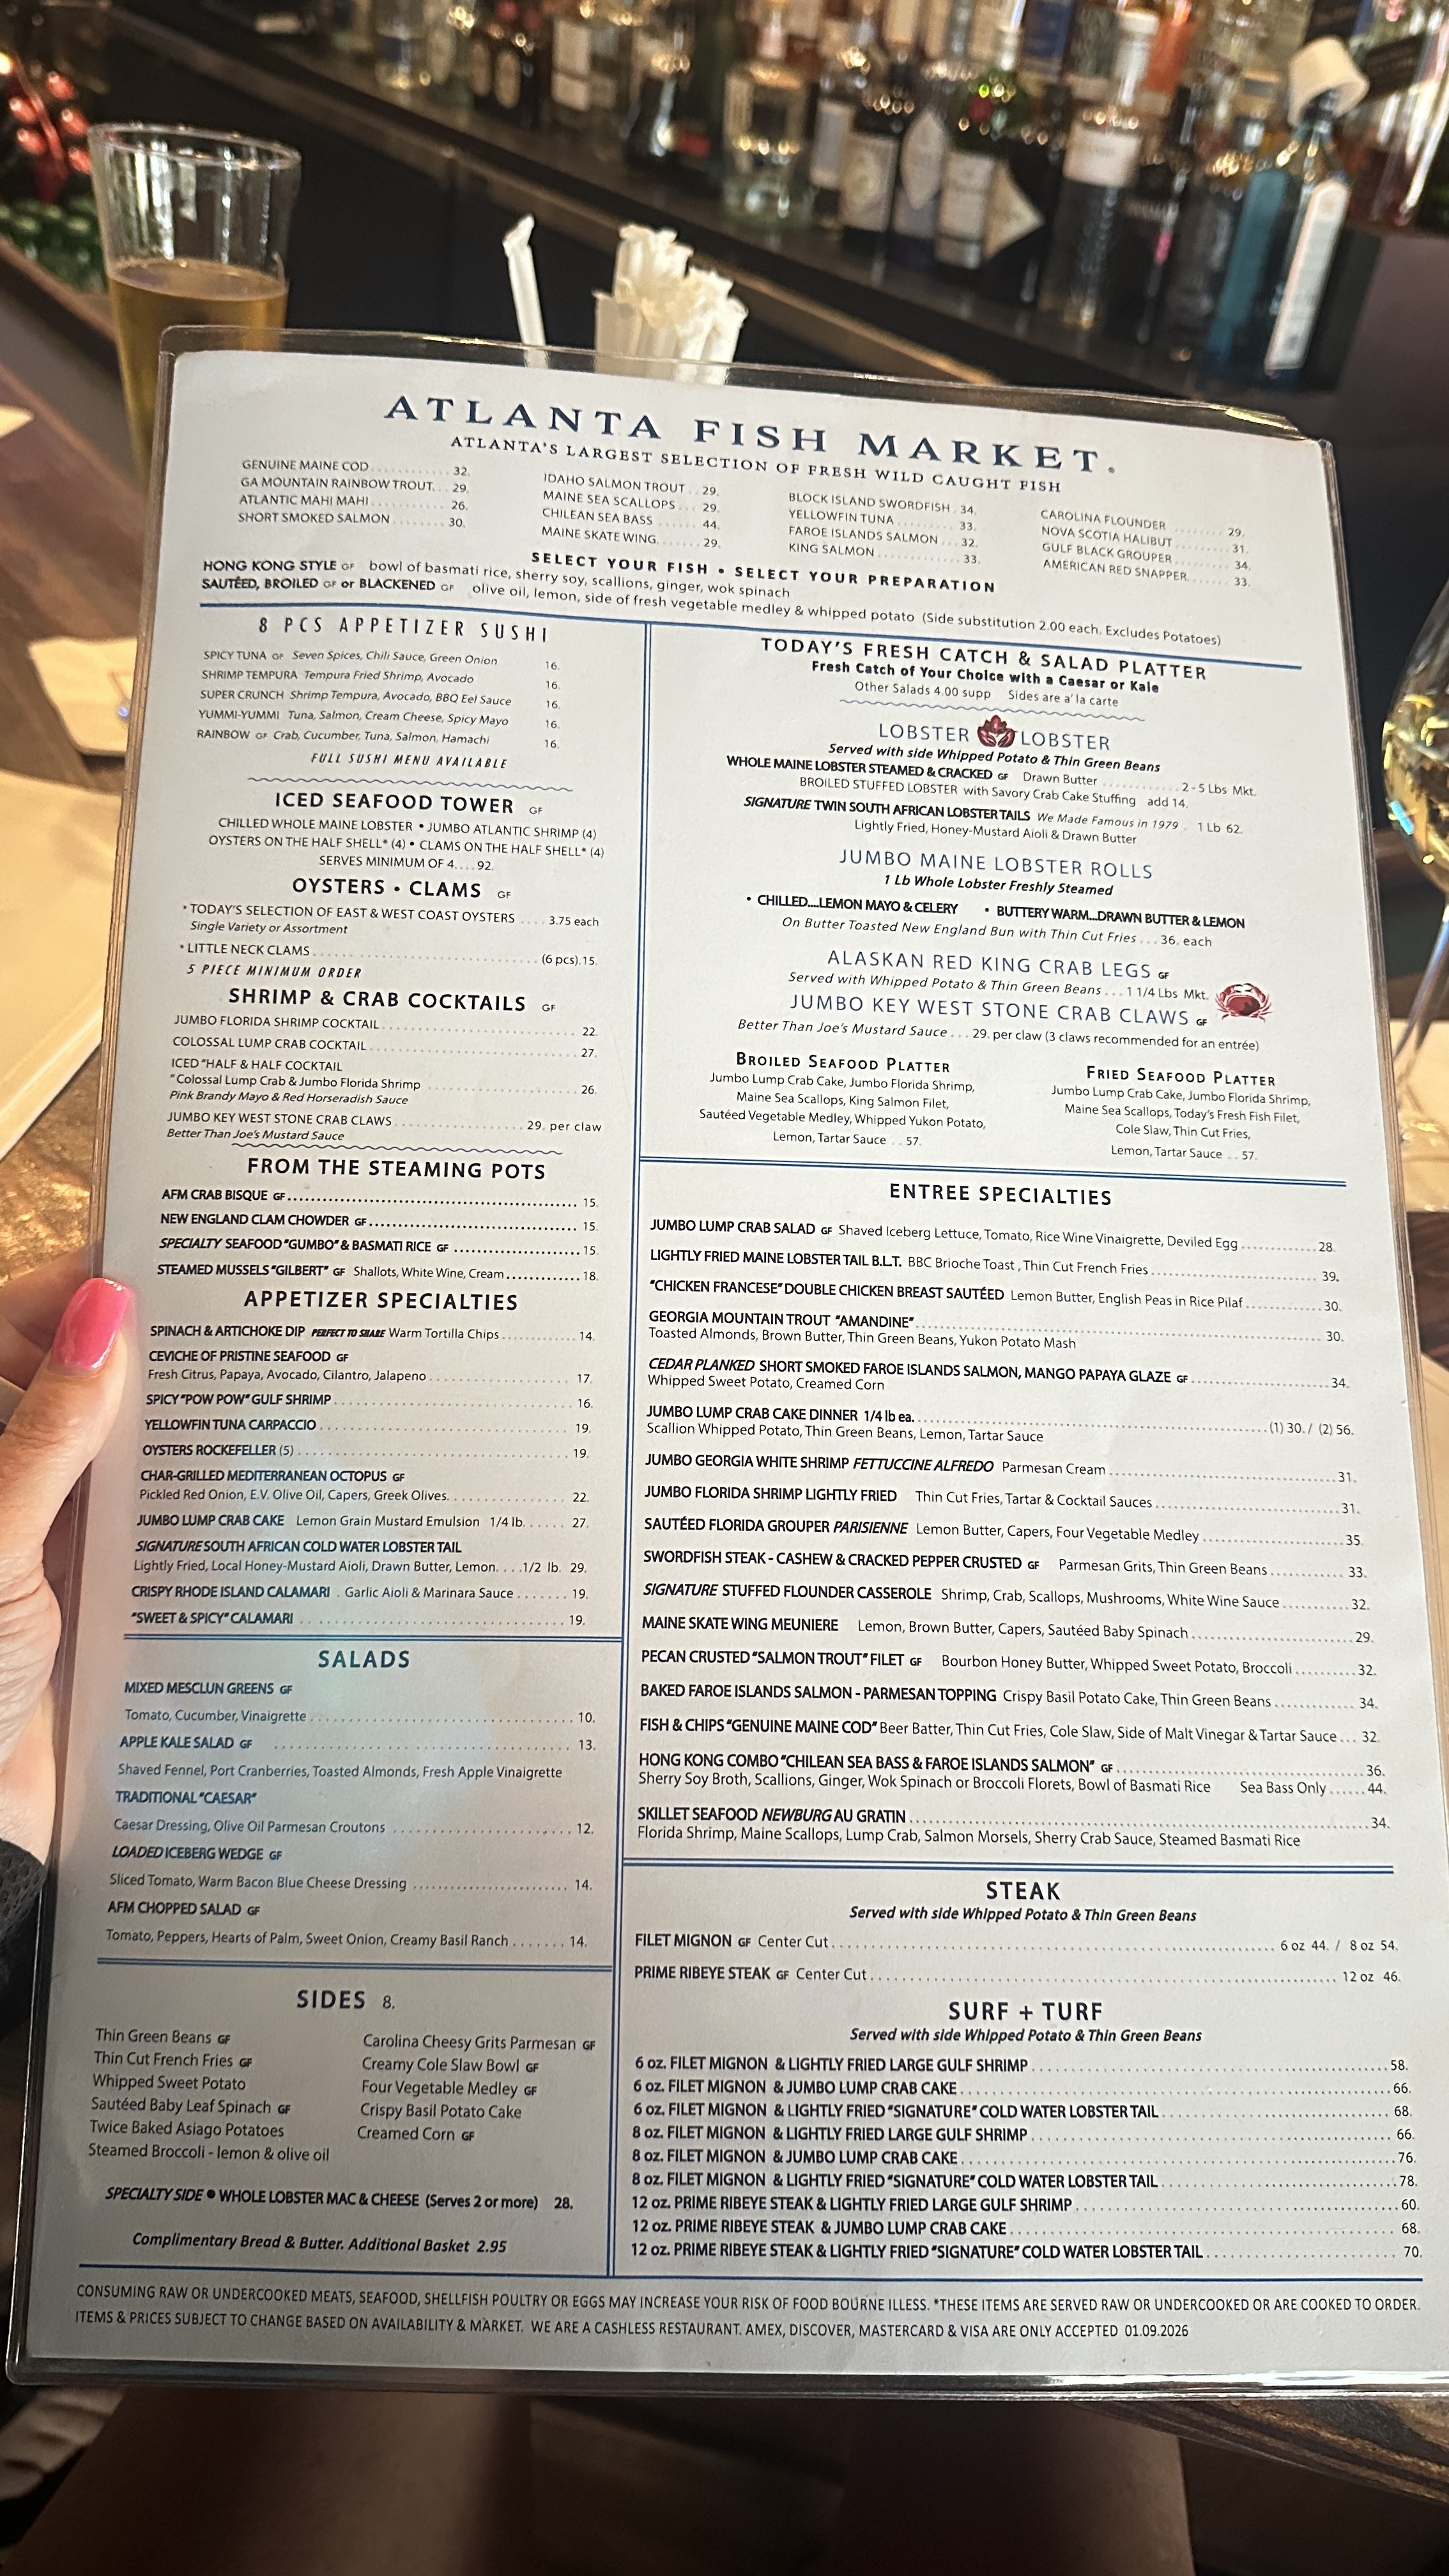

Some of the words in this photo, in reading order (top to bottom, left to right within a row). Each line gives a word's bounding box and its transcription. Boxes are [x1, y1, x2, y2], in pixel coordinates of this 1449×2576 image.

[383, 395, 661, 440] ATLANTA
[694, 419, 826, 452] FISH
[858, 433, 1098, 473] MARKET
[241, 459, 296, 470] GENUINE
[299, 459, 339, 471] MAINE
[342, 461, 369, 472] COD
[450, 436, 558, 455] ATLANTA'S
[566, 445, 652, 463] LARGEST
[661, 453, 767, 472] SELECTION
[776, 463, 799, 474] OF
[808, 464, 866, 479] FRESH
[875, 470, 924, 483] WILD
[932, 475, 1011, 490] CAUGHT
[1020, 480, 1060, 493] FISH
[542, 507, 595, 521] CHILEAN
[597, 512, 620, 523] SEA
[623, 514, 653, 526] BASS
[788, 509, 857, 523] YELLOWFIN
[860, 514, 894, 525] TUNA
[1040, 509, 1101, 524] CAROLINA
[1104, 514, 1166, 530] FLOUNDER
[532, 552, 597, 567] SELECT
[607, 558, 657, 572] YOUR
[667, 562, 707, 574] FISH
[735, 566, 799, 581] SELECT
[809, 571, 858, 585] YOUR
[868, 574, 994, 593] PREPARATION
[259, 617, 268, 633] 8
[284, 617, 322, 633] PCS
[339, 617, 464, 636] APPETIZER
[480, 622, 546, 643] SUSHI
[761, 637, 853, 656] TODAY'S
[864, 643, 928, 660] FRESH
[940, 648, 1008, 664] CATCH
[1018, 650, 1031, 666] &
[1041, 654, 1108, 671] SALAD
[1119, 659, 1206, 680] PLATTER
[201, 670, 244, 680] SHRIMP
[245, 670, 298, 680] TEMPURA
[304, 670, 351, 682] Tempura
[353, 670, 381, 680] Fried
[383, 670, 424, 684] Shrimp,
[426, 672, 474, 684] Avocado
[879, 723, 969, 742] LOBSTER
[1021, 730, 1110, 751] LOBSTER
[275, 792, 324, 808] ICED
[332, 793, 433, 810] SEAFOOD
[440, 795, 513, 814] TOWER
[529, 806, 543, 815] GF
[839, 849, 911, 866] JUMBO
[921, 853, 986, 870] MAINE
[995, 856, 1082, 875] LOBSTER
[1091, 861, 1152, 879] ROLLS
[293, 877, 385, 895] OYSTERS
[410, 880, 481, 898] CLAMS
[497, 891, 511, 899] GF
[190, 921, 226, 933] Single
[228, 921, 267, 935] Variety
[282, 923, 349, 934] Assortment
[827, 950, 923, 969] ALASKAN
[933, 954, 972, 970] RED
[982, 956, 1030, 973] KING
[1039, 959, 1092, 976] CRAB
[1102, 962, 1151, 979] LEGS
[229, 988, 311, 1005] SHRIMP
[320, 990, 335, 1006] &
[342, 990, 399, 1008] CRAB
[408, 992, 525, 1011] COCKTAILS
[542, 1004, 556, 1012] GF
[737, 1091, 772, 1103] Maine
[774, 1092, 794, 1103] Sea
[797, 1093, 846, 1107] Scallops,
[849, 1095, 875, 1109] King
[877, 1096, 919, 1108] Salmon
[923, 1098, 949, 1110] Filet,
[248, 1158, 309, 1174] FROM
[318, 1158, 360, 1176] THE
[369, 1160, 482, 1178] STEAMING
[491, 1163, 545, 1180] POTS
[890, 1183, 970, 1200] ENTREE
[979, 1186, 1111, 1206] SPECIALTIES
[160, 1213, 189, 1224] NEW
[191, 1213, 249, 1225] ENGLAND
[251, 1213, 286, 1225] CLAM
[288, 1214, 349, 1227] CHOWDER
[354, 1218, 367, 1227] GF
[243, 1290, 367, 1308] APPETIZER
[377, 1292, 518, 1311] SPECIALTIES
[144, 1419, 211, 1430] YELLOWFIN
[211, 1418, 247, 1430] TUNA
[249, 1419, 317, 1430] CARPACCIO
[576, 1423, 591, 1434] 19.
[642, 1616, 686, 1629] MAINE
[688, 1616, 729, 1630] SKATE
[730, 1617, 768, 1630] WING
[770, 1618, 839, 1632] MEUNIERE
[858, 1620, 905, 1634] Lemon,
[909, 1620, 949, 1633] Brown
[953, 1621, 995, 1636] Butter,
[998, 1622, 1045, 1638] Capers,
[1048, 1623, 1100, 1637] Sautéed
[1103, 1625, 1135, 1641] Baby
[1138, 1625, 1188, 1641] Spinach
[318, 1650, 410, 1669] SALADS
[114, 1818, 154, 1831] Caesar
[156, 1819, 211, 1835] Dressing,
[213, 1820, 245, 1832] Olive
[247, 1820, 264, 1832] Oil
[267, 1820, 326, 1833] Parmesan
[329, 1821, 385, 1834] Croutons
[577, 1822, 594, 1835] 12.
[986, 1881, 1061, 1901] STEAK
[634, 1965, 677, 1979] PRIME
[679, 1965, 725, 1979] RIBEYE
[728, 1966, 771, 1980] STEAK
[776, 1970, 790, 1981] GF
[796, 1967, 840, 1981] Center
[843, 1968, 867, 1981] Cut
[1343, 1971, 1357, 1982] 12
[1360, 1973, 1374, 1982] oz
[1383, 1971, 1401, 1982] 46.
[296, 1989, 365, 2009] SIDES
[382, 1995, 395, 2009] 8.
[949, 2001, 1009, 2021] SURF
[1019, 2005, 1034, 2021] +
[1041, 2002, 1102, 2021] TURF
[94, 2050, 123, 2065] Thin
[126, 2051, 151, 2066] Cut
[153, 2051, 199, 2067] French
[202, 2053, 233, 2067] Fries
[239, 2057, 253, 2068] GF
[357, 2126, 419, 2140] Creamed
[422, 2126, 455, 2142] Corn
[461, 2131, 475, 2142] GF
[132, 2232, 238, 2250] Complimentary
[240, 2234, 282, 2248] Bread
[284, 2235, 295, 2249] &
[299, 2236, 344, 2250] Butter.
[348, 2237, 422, 2252] Additional
[423, 2238, 470, 2253] Basket
[476, 2239, 507, 2253] 2.95
[745, 2323, 786, 2338] AMEX,
[790, 2323, 855, 2339] DISCOVER,
[859, 2324, 944, 2337] MASTERCARD
[947, 2324, 957, 2338] &
[960, 2324, 989, 2338] VISA
[992, 2325, 1016, 2338] ARE
[1020, 2324, 1052, 2338] ONLY
[1055, 2324, 1118, 2338] ACCEPTED
[1124, 2324, 1189, 2337] 01.09.2026
